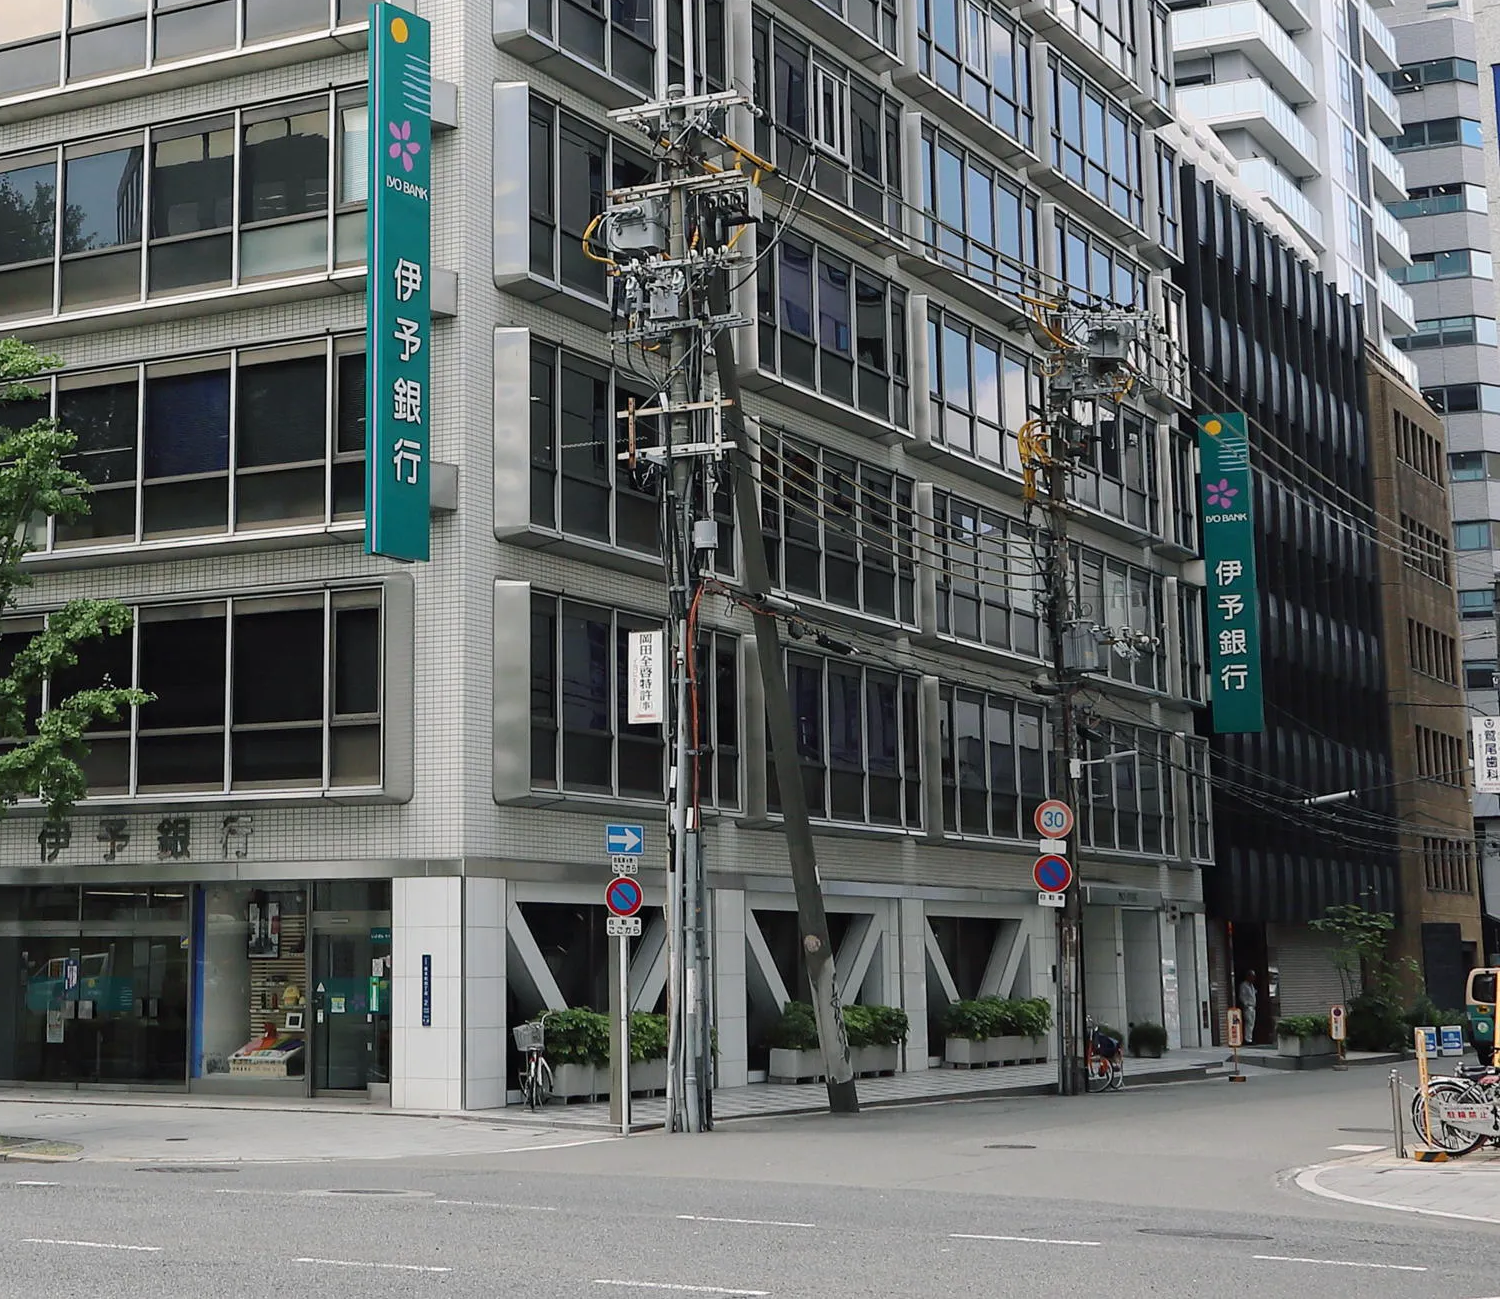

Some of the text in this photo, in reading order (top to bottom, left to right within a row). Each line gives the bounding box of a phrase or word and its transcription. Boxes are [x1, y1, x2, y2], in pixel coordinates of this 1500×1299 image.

[386, 174, 429, 202] IYO BANK
[393, 257, 423, 485] 伊予銀行
[1205, 512, 1248, 523] IYO BANK
[1215, 559, 1249, 691] 伊予銀行
[1043, 810, 1065, 828] 30
[37, 815, 254, 864] 伊予銀行
[613, 863, 638, 873] ここから
[608, 926, 641, 935] ここから
